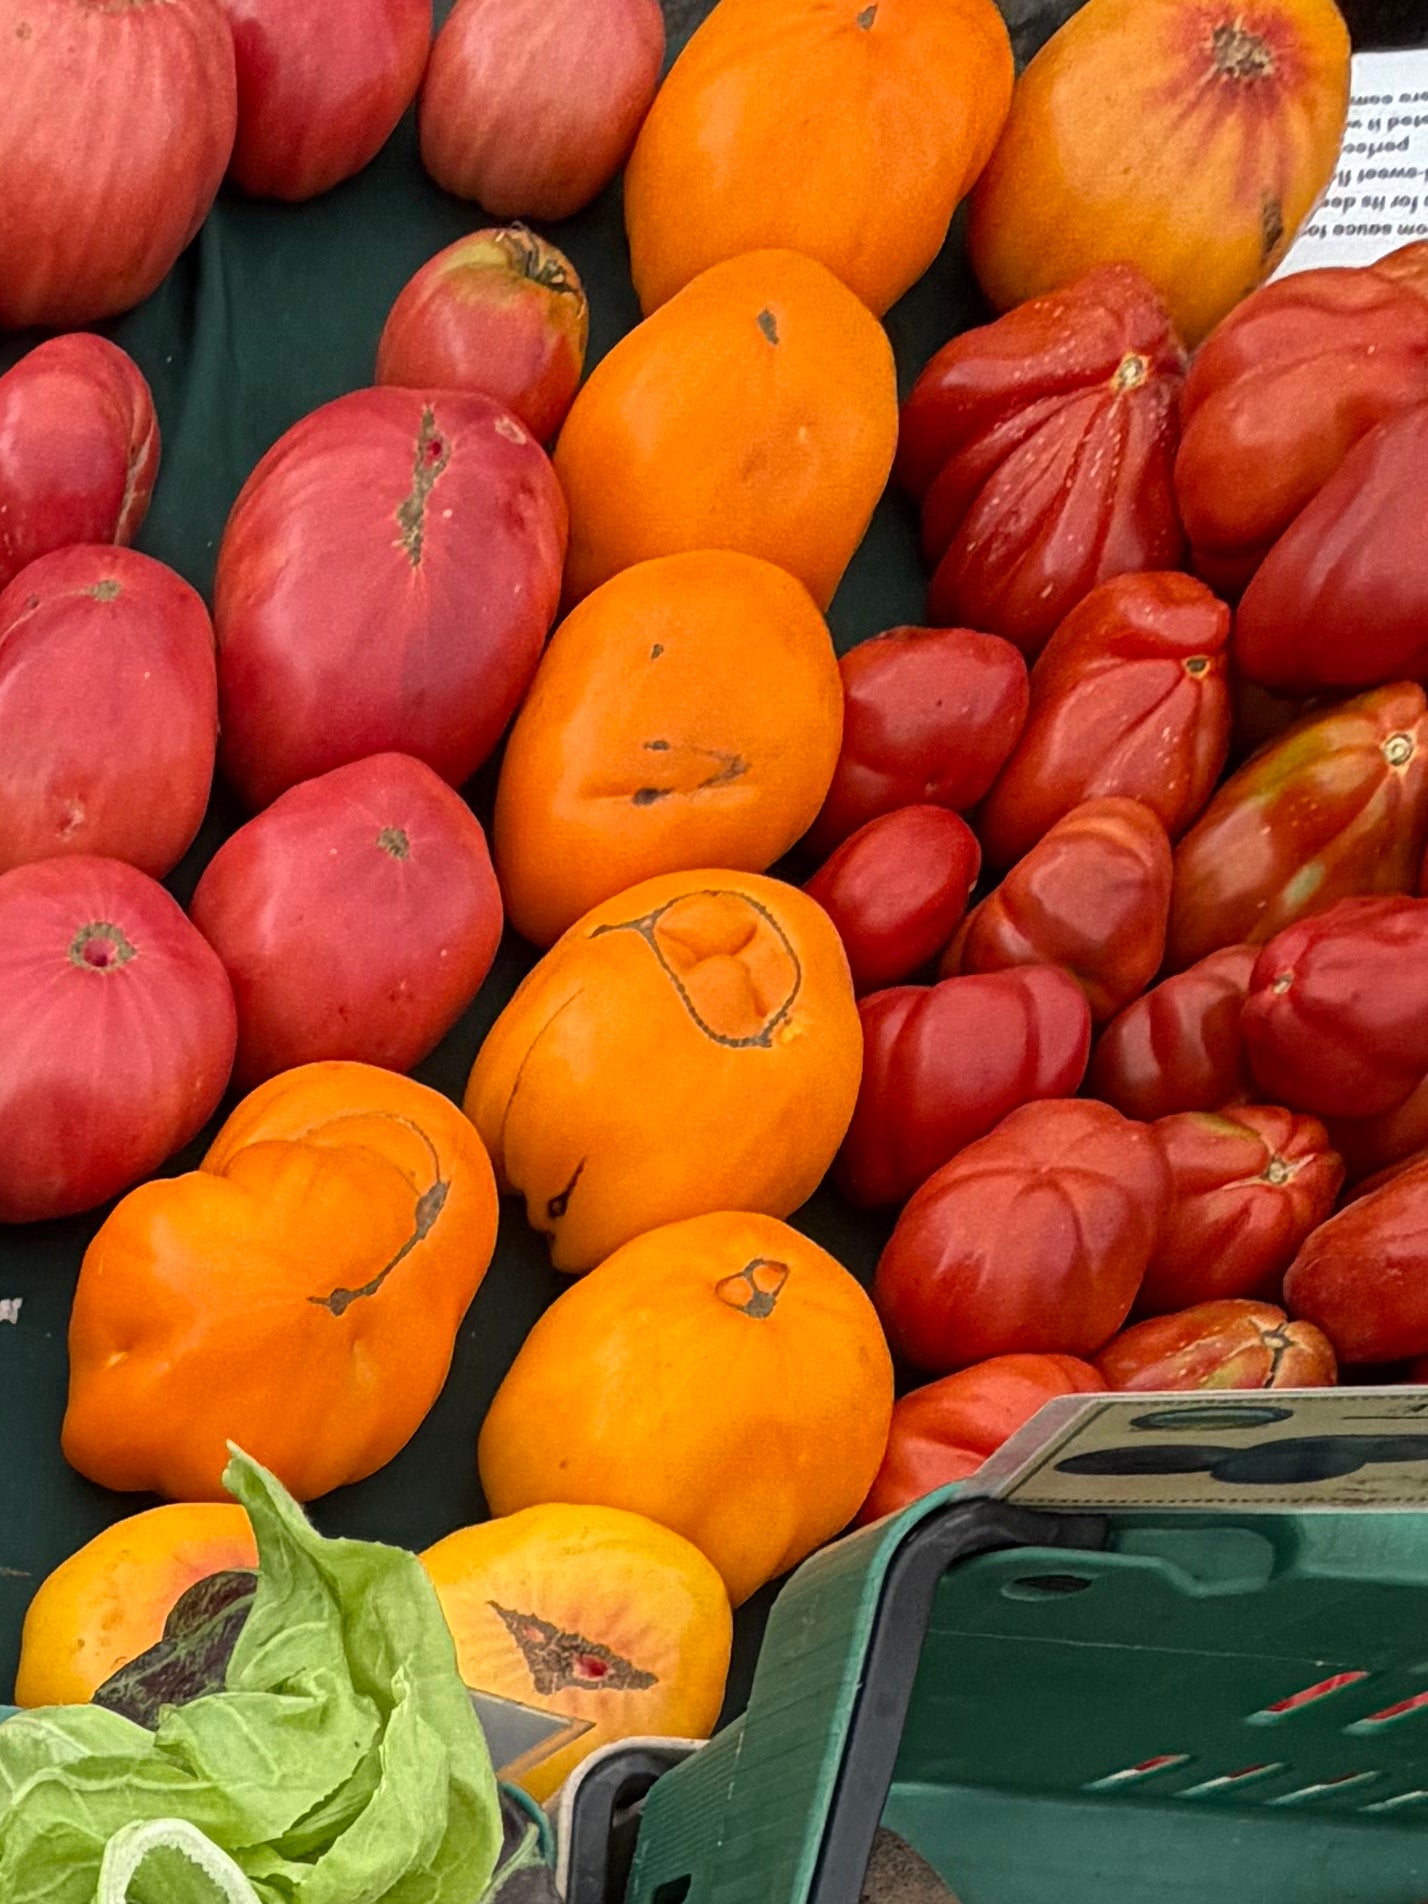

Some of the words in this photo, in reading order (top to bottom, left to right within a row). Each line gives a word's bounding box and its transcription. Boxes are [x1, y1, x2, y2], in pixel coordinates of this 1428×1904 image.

[1342, 135, 1410, 160] perfec
[1333, 169, 1352, 188] fl
[1361, 195, 1387, 213] its
[1390, 195, 1419, 215] for
[1333, 223, 1392, 236] sauce
[1397, 223, 1428, 236] om
